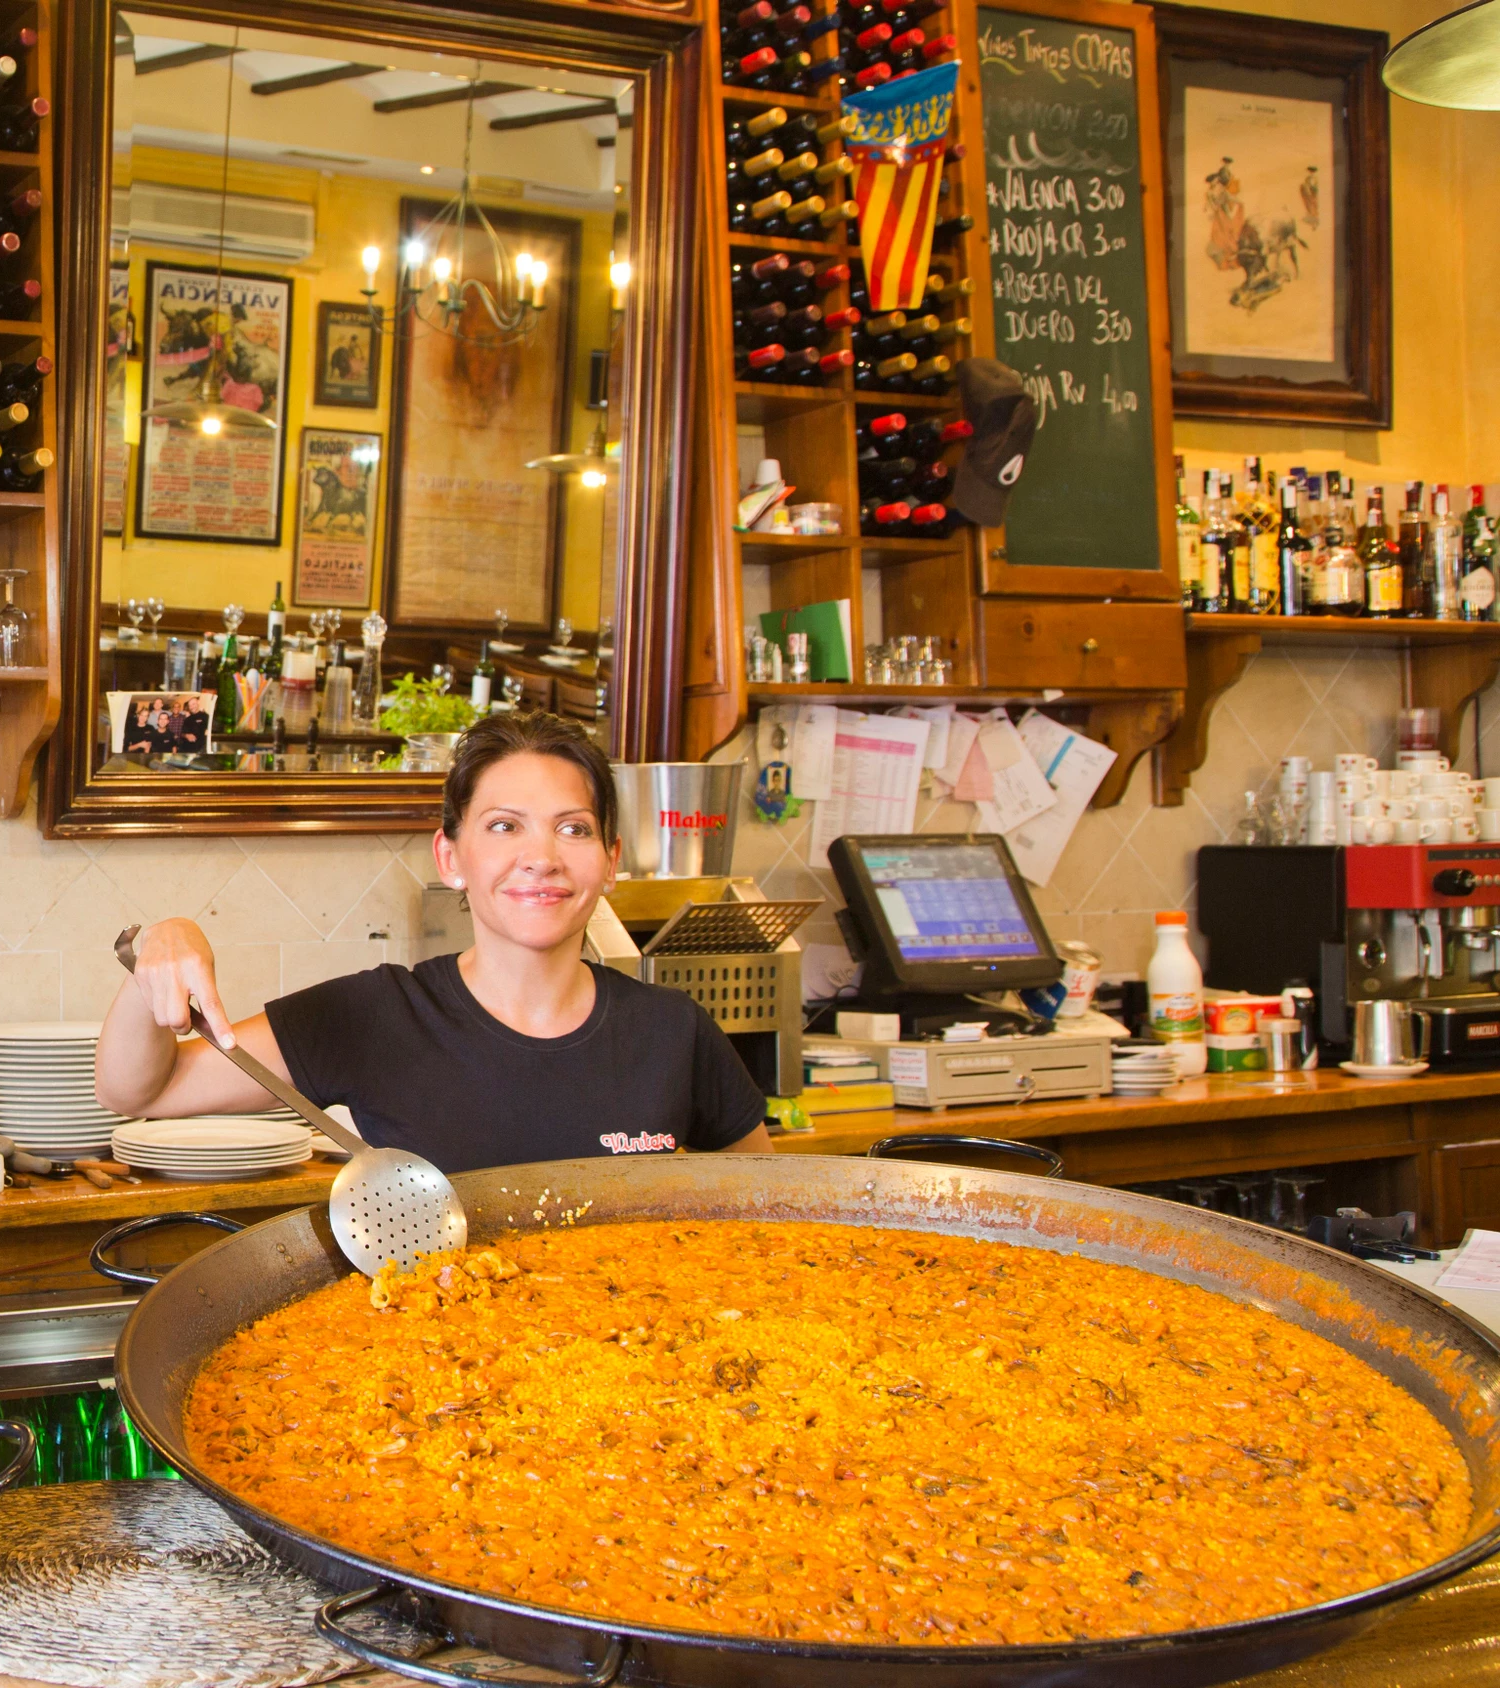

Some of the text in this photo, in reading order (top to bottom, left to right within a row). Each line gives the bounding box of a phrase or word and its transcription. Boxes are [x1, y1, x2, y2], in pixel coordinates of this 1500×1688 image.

[1072, 33, 1133, 79] COPAS
[1074, 274, 1109, 305] DEL
[1004, 309, 1075, 343] DUERO
[1469, 1024, 1498, 1037] MARCILLA
[599, 1130, 675, 1154] Vintara
